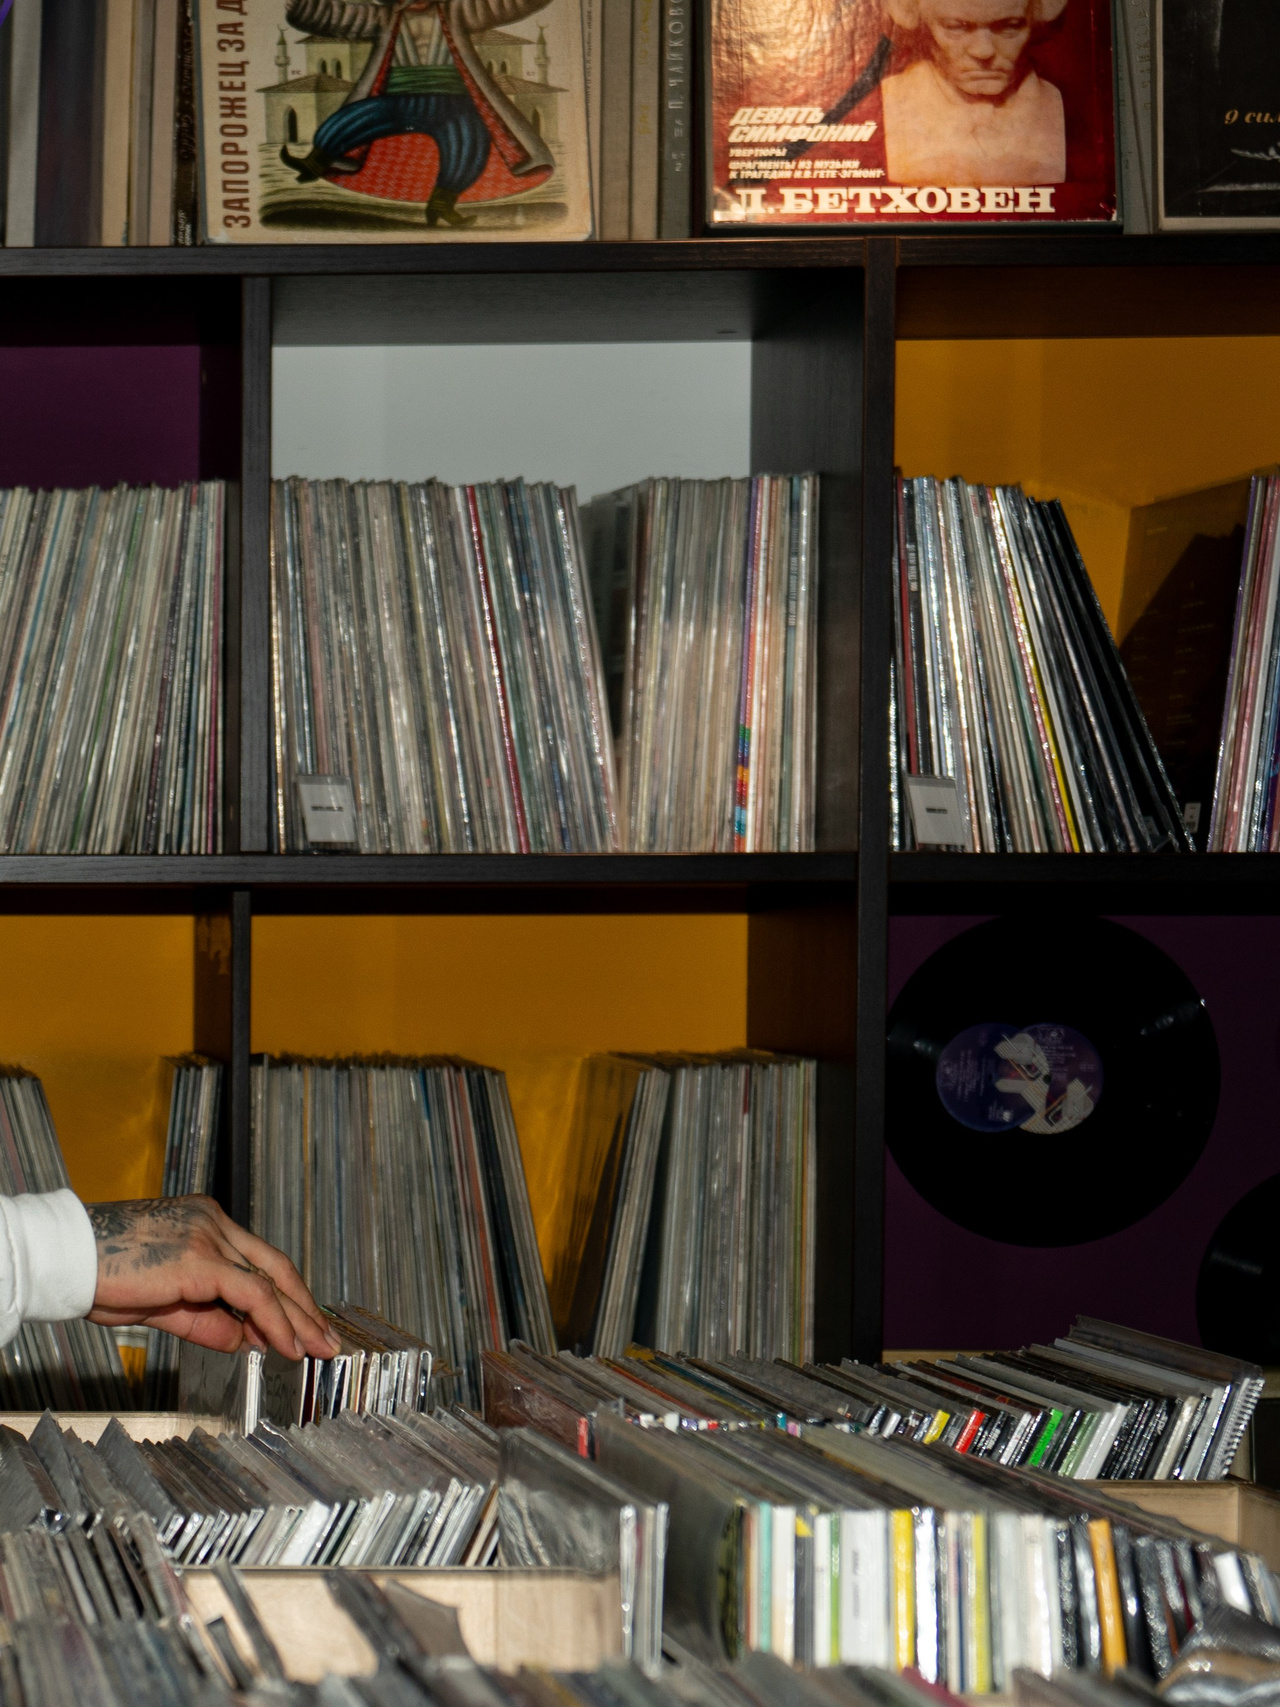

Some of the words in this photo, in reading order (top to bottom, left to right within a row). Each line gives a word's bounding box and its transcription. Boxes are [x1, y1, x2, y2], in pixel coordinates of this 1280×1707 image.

[217, 17, 247, 52] ЗА
[728, 105, 824, 126] ДЕВЯТЬ
[1223, 109, 1239, 125] 9
[728, 121, 878, 143] СИМФОНИЙ
[217, 61, 250, 229] ЗАПОРОЖЕЦ
[729, 147, 787, 158] УВЕРТЮРЫ
[728, 159, 797, 170] ФРАГМЕНТЫ
[798, 159, 813, 169] ИЗ
[814, 159, 860, 169] МУЗЫКИ
[729, 169, 739, 179] К
[740, 169, 793, 179] ТРАГЕДИИ
